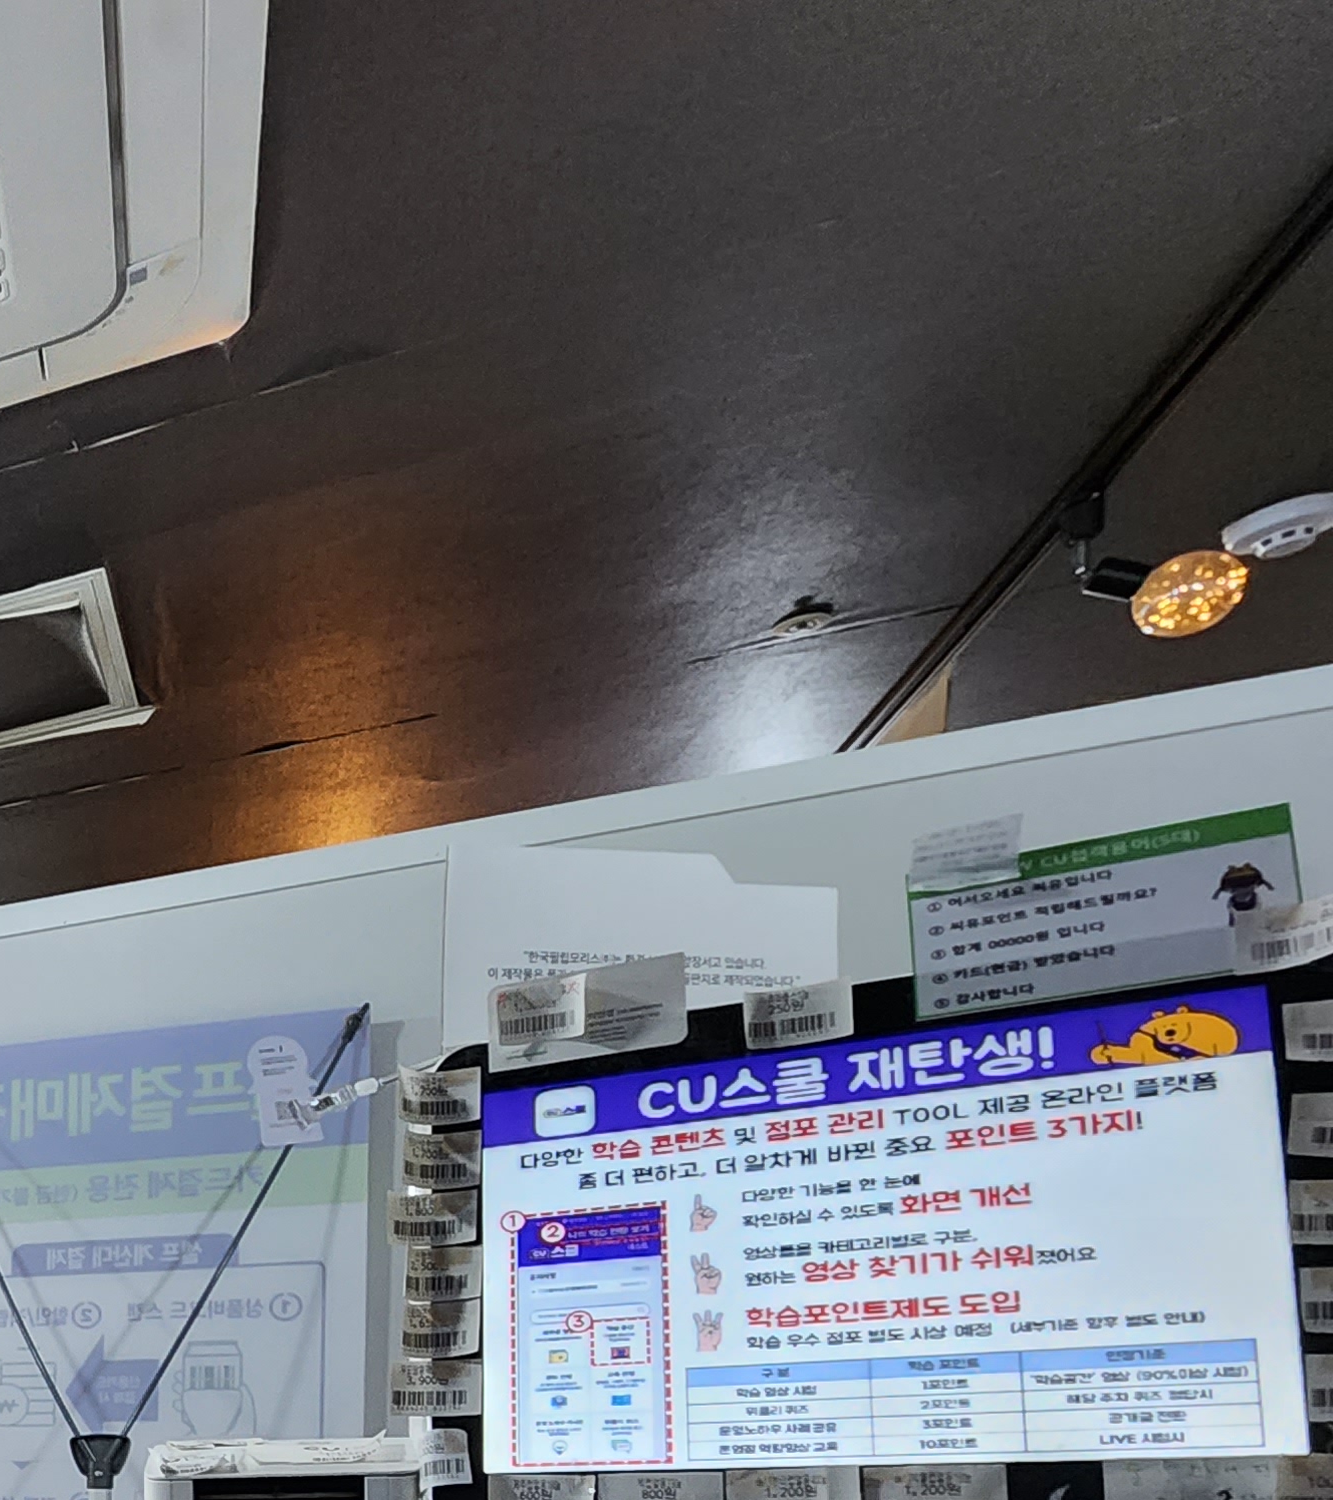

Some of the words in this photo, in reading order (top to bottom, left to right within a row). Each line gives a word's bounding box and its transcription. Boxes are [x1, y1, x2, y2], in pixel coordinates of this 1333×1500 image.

[947, 884, 1027, 909] 어서오세요
[951, 940, 983, 957] 합계
[1056, 920, 1106, 940] 입니다
[487, 968, 499, 980] 이
[955, 983, 1035, 1006] 감사합니다
[638, 1056, 829, 1119] CU스쿨
[846, 1025, 1055, 1094] 재탄생!
[520, 1147, 583, 1170] 다양한
[591, 1138, 642, 1161] 학습
[649, 1127, 727, 1156] 콘텐츠
[734, 1126, 757, 1145] 및
[764, 1117, 820, 1143] 점포
[826, 1109, 885, 1135] 관리
[892, 1102, 969, 1126] TOOL
[978, 1094, 1031, 1116] 제공
[1040, 1082, 1125, 1110] 온라인
[1133, 1070, 1219, 1099] 플랫폼
[577, 1169, 598, 1190] 좀
[604, 1168, 625, 1187] 더
[631, 1160, 707, 1184] 편하고,
[715, 1156, 737, 1175] 더
[743, 1147, 818, 1174] 알차게
[826, 1140, 876, 1163] 바뀐
[884, 1135, 937, 1157] 중요
[945, 1119, 1039, 1151] 포인트
[1046, 1108, 1145, 1141] 3가지!
[740, 1185, 797, 1204] 다양한
[803, 1179, 854, 1198] 기능을
[858, 1176, 878, 1194] 한
[883, 1172, 922, 1189] 눈에
[741, 1208, 814, 1229] 확인하실
[817, 1206, 835, 1223] 수
[840, 1201, 895, 1220] 있도록
[899, 1191, 962, 1216] 화면
[969, 1183, 1032, 1207] 개선
[743, 1241, 813, 1262] 영상들을
[817, 1231, 928, 1255] 카테고리별로
[744, 1269, 797, 1288] 원하는
[801, 1258, 859, 1284] 영상
[868, 1251, 962, 1280] 찾기가
[971, 1244, 1098, 1271] 쉬워졌어요
[744, 1296, 952, 1329] 학습포인트제도
[959, 1290, 1021, 1315] 도입
[746, 1334, 781, 1350] 학습
[786, 1332, 820, 1348] 우수
[826, 1329, 862, 1346] 점포
[867, 1327, 906, 1343] 별도
[909, 1325, 947, 1341] 시상
[953, 1322, 993, 1338] 예정
[1085, 1315, 1119, 1330] 향후
[1099, 1433, 1137, 1446] LIVE
